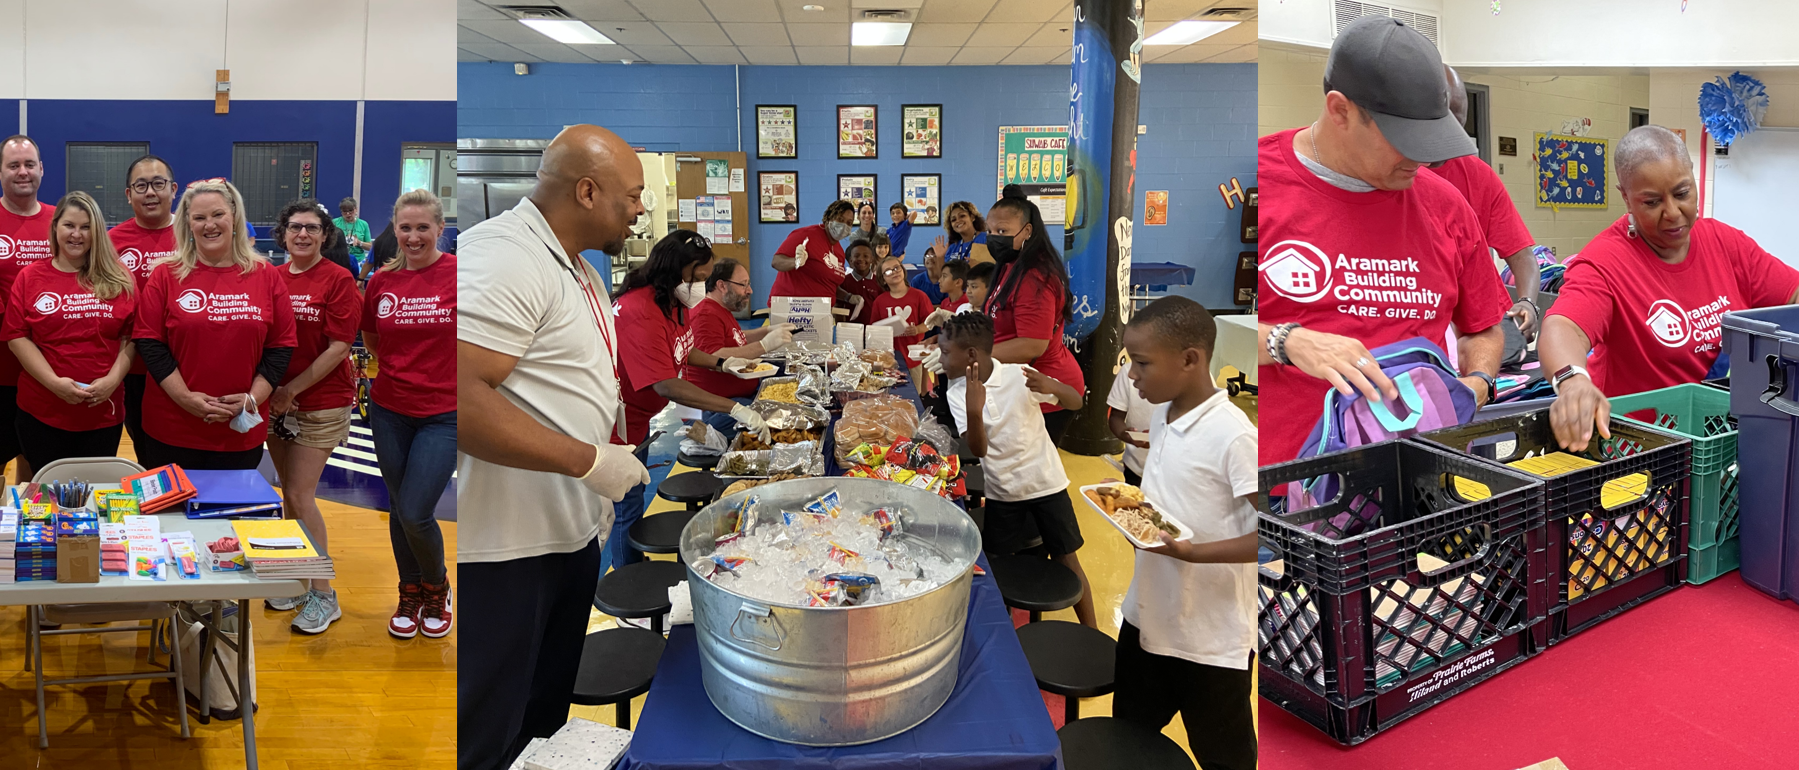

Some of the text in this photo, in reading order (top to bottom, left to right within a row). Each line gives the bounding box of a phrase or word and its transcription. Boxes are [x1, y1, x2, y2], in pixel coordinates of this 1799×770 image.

[19, 245, 51, 253] Building
[1334, 253, 1420, 272] Aramark
[1343, 272, 1417, 290] Building
[208, 292, 250, 301] Aramark
[399, 295, 441, 304] Aramark
[1333, 285, 1442, 308] Community
[66, 298, 100, 306] Building
[61, 303, 114, 312] Community
[206, 305, 262, 315] Community
[402, 303, 437, 311] Building
[1337, 304, 1381, 317] CARE.
[1385, 307, 1421, 319] GIVE.
[394, 308, 452, 317] Community
[252, 314, 263, 322] DO.
[788, 316, 812, 325] Hefty
[1443, 672, 1459, 686] and
[1460, 657, 1495, 678] Roberts
[1407, 681, 1428, 694] PROPERTY
[1432, 661, 1464, 681] Prairie
